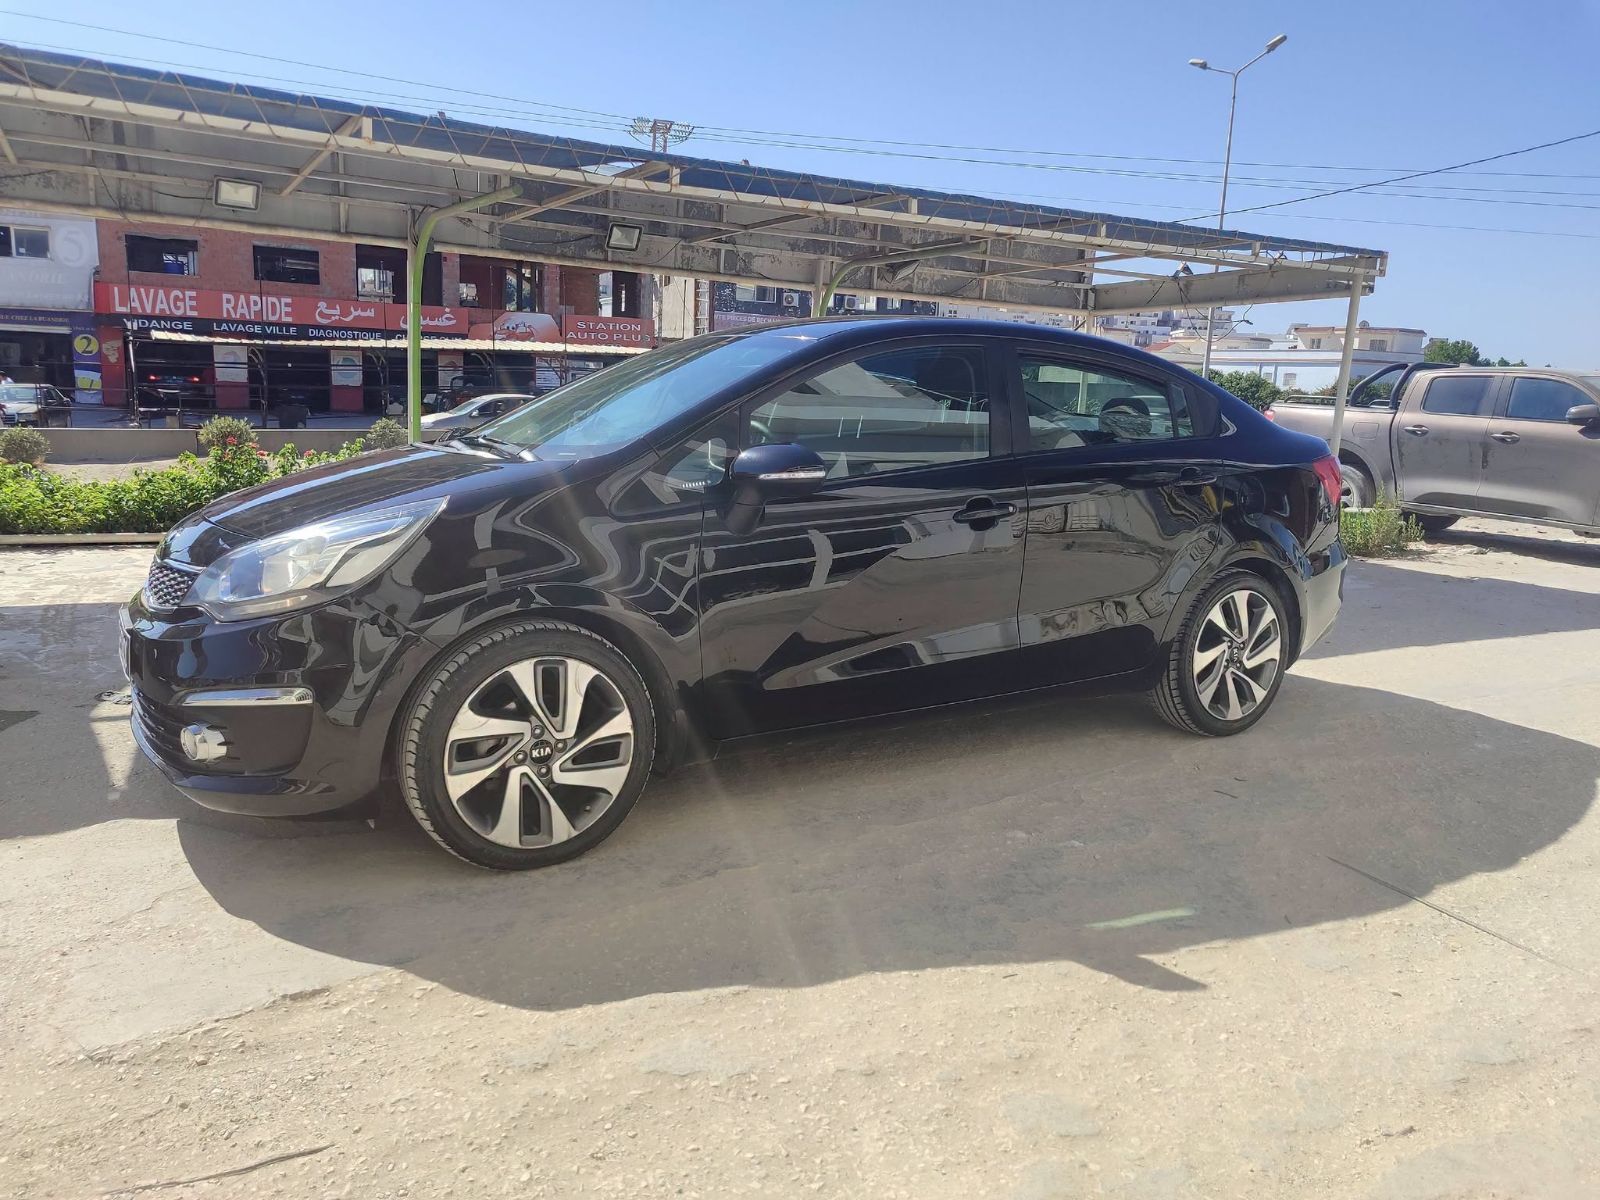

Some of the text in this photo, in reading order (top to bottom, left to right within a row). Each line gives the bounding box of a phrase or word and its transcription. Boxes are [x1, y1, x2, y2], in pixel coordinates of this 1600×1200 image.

[113, 286, 293, 322] LAVAGE RAPIDE
[315, 301, 375, 324] سريع
[213, 322, 262, 333] LAVAGE
[264, 325, 297, 336] VILLE
[309, 328, 382, 340] DIAGNOSTIQUE
[576, 320, 641, 331] STATION
[80, 336, 93, 355] 2
[566, 331, 651, 342] AUTO PLUS
[532, 747, 551, 758] KIA
